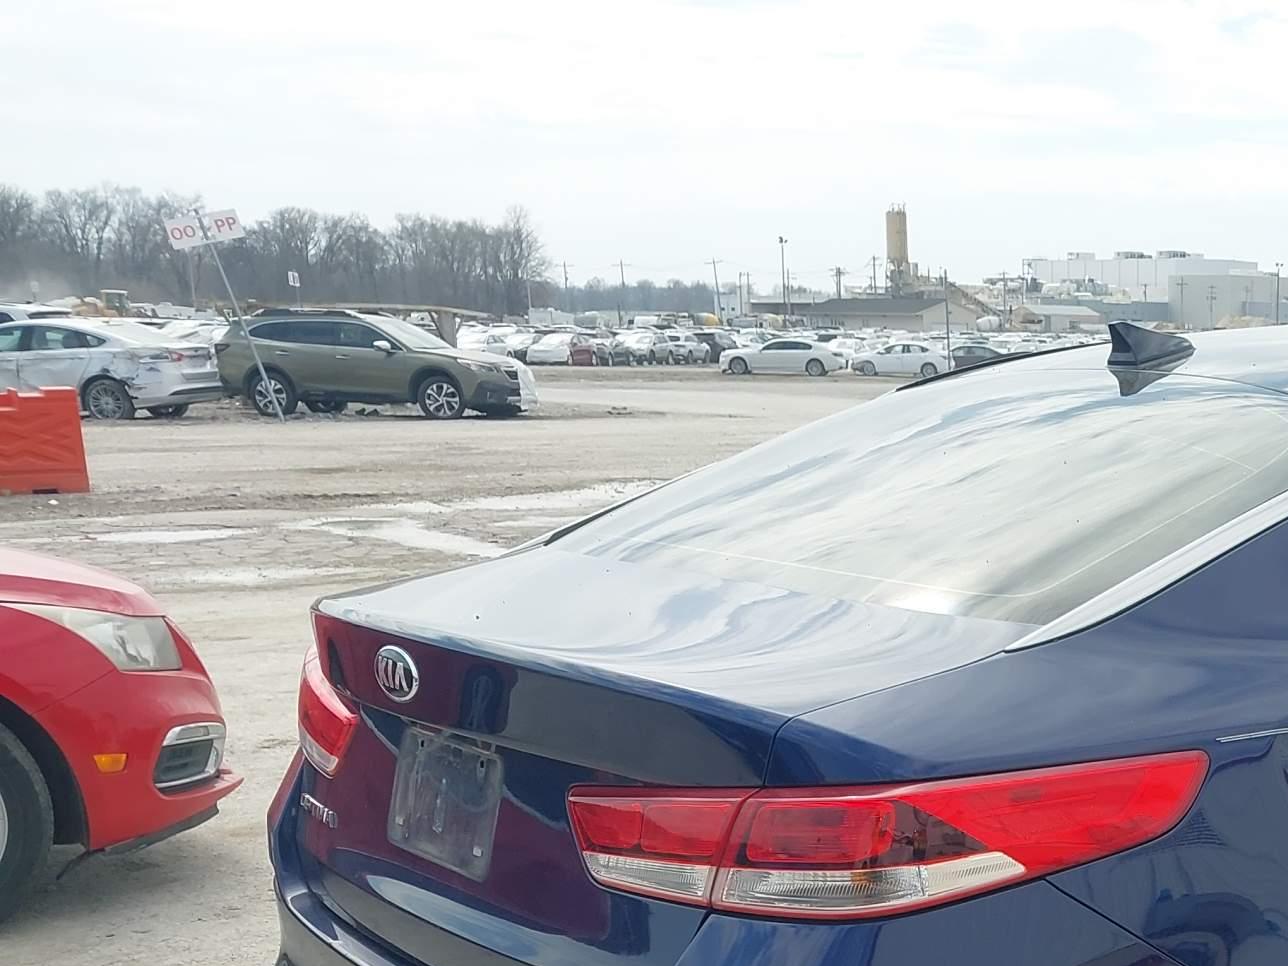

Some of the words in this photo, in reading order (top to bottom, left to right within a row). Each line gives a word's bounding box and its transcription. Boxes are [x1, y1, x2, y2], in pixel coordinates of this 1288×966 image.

[214, 217, 236, 232] PP
[170, 225, 196, 240] OO
[378, 655, 410, 692] KIA
